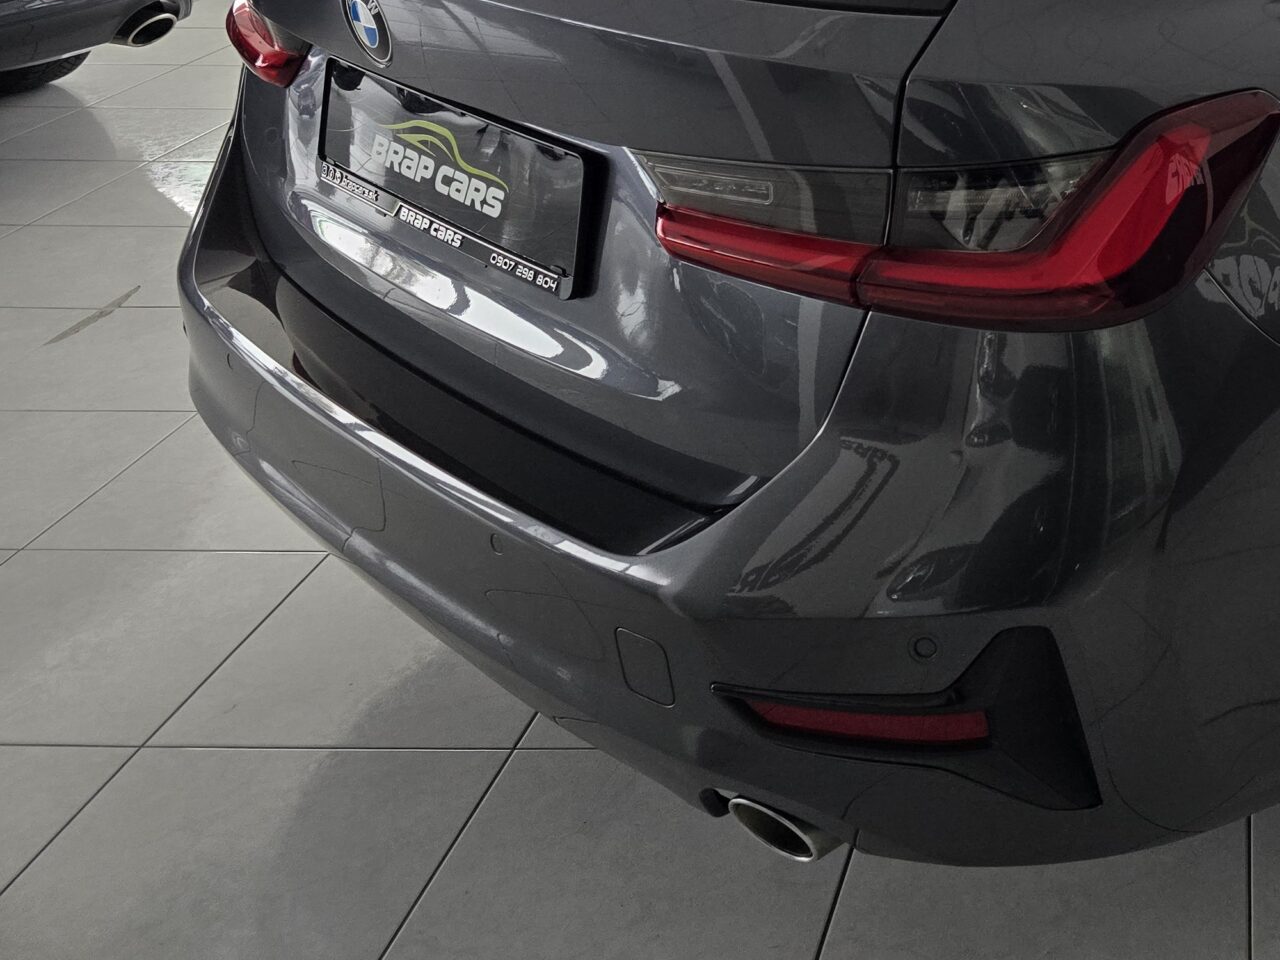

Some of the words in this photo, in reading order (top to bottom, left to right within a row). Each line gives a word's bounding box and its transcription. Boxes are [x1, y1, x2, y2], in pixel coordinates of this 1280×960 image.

[489, 253, 515, 271] 0907
[515, 265, 535, 281] 298
[535, 274, 558, 292] 804
